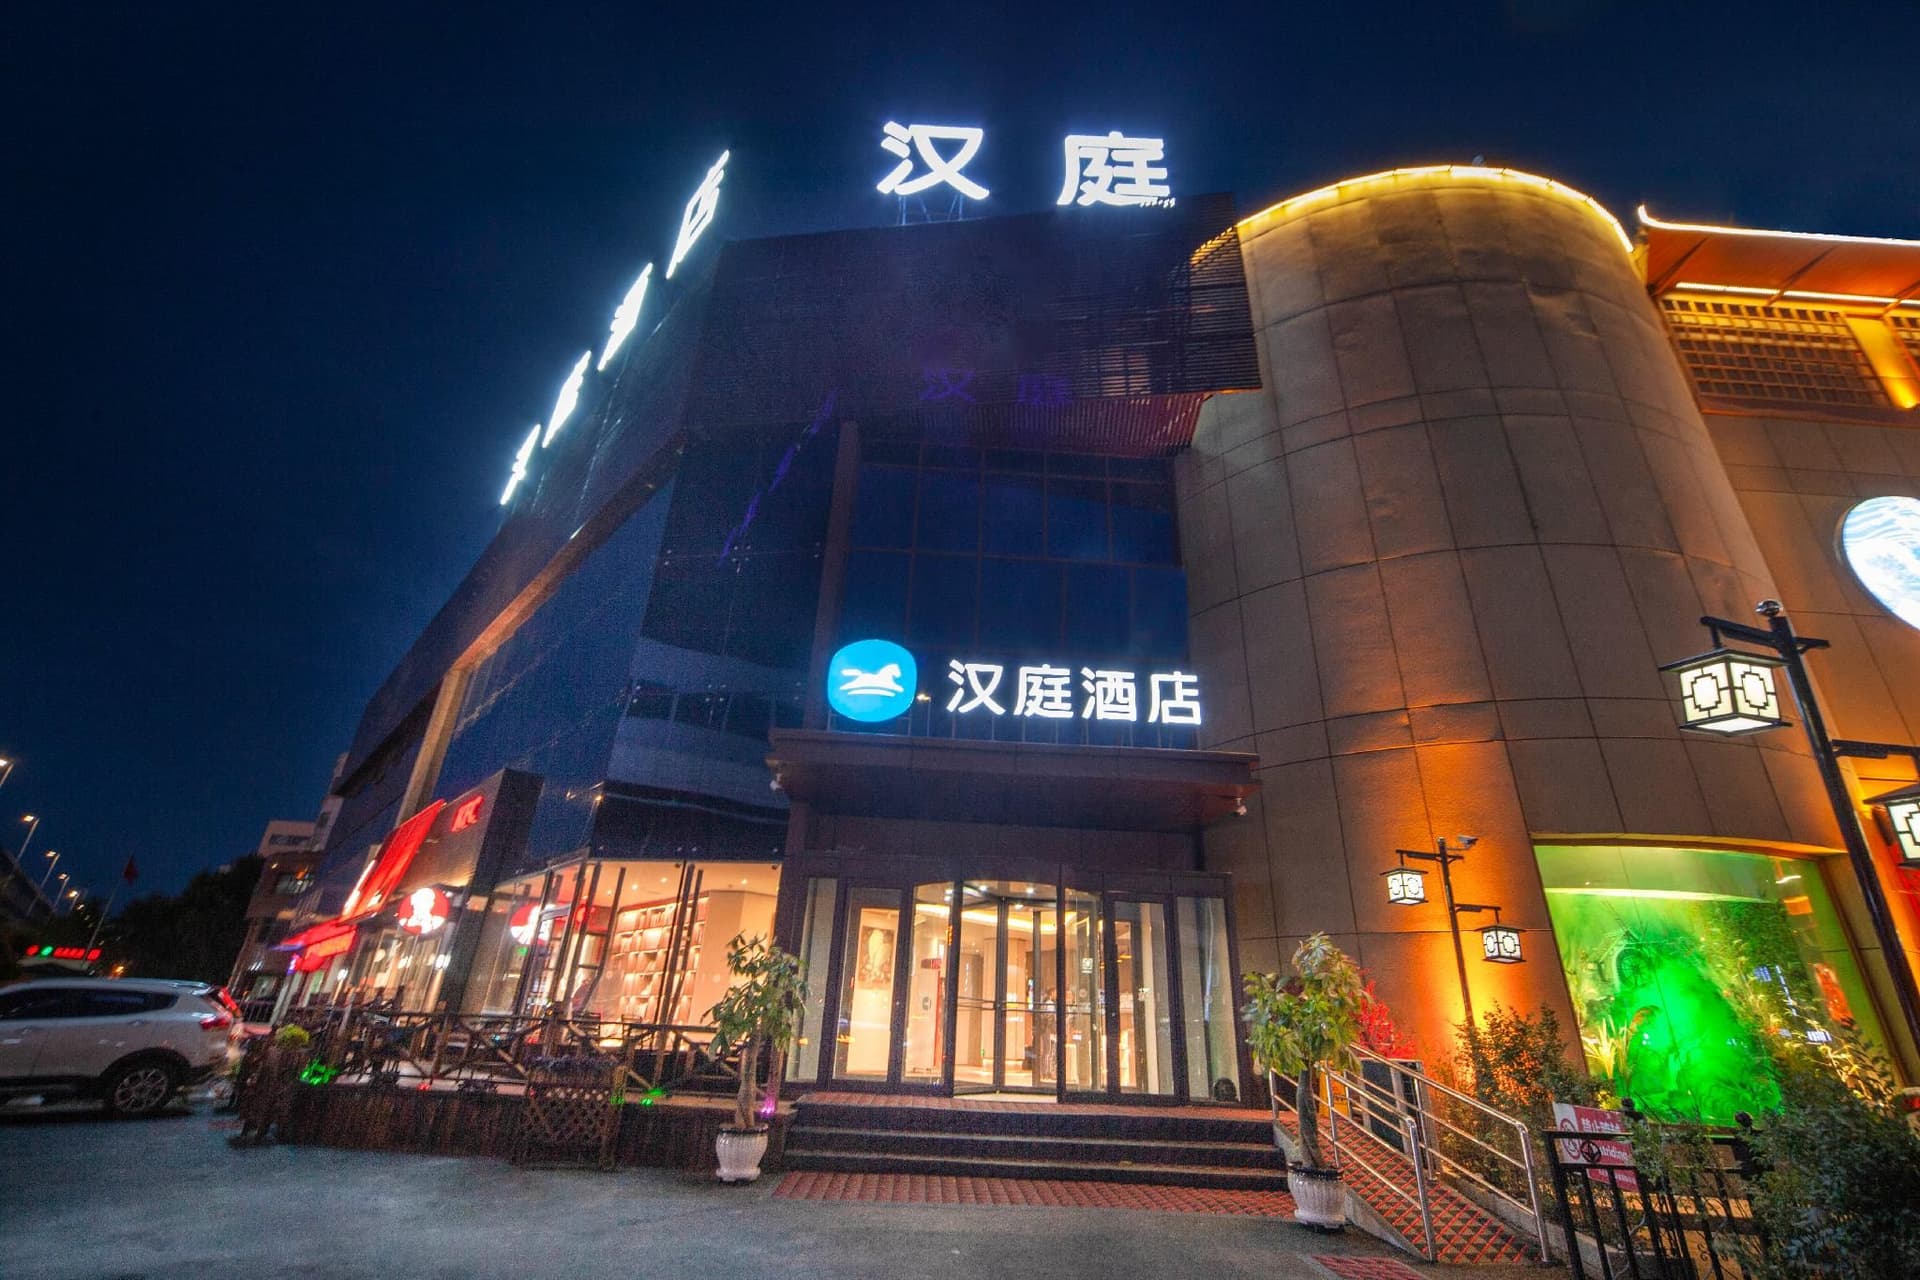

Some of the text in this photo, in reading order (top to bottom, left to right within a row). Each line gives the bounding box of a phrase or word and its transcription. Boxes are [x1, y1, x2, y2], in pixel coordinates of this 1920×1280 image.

[877, 121, 1175, 208] 汉庭
[946, 659, 1202, 725] 汉庭酒店
